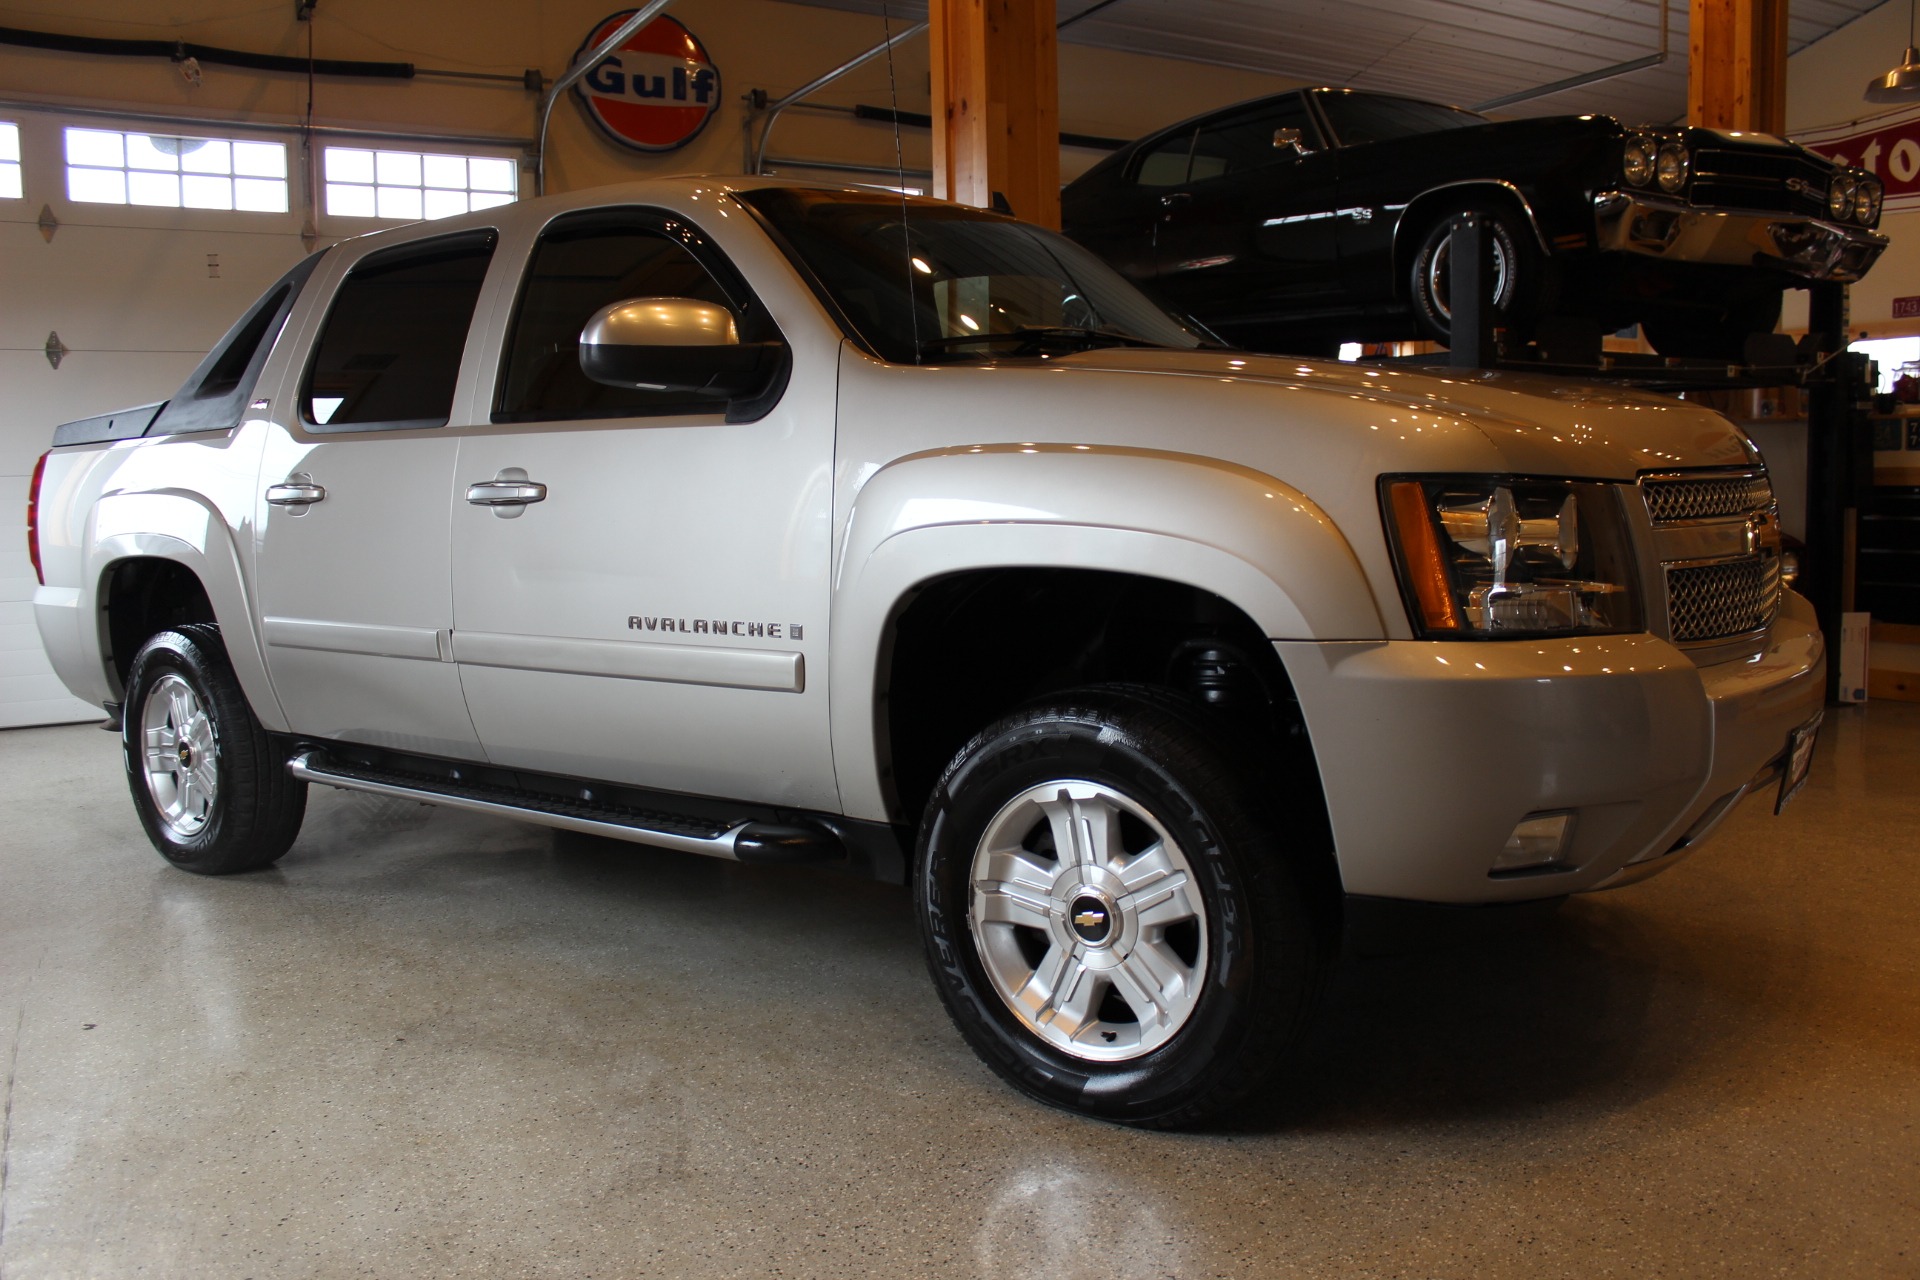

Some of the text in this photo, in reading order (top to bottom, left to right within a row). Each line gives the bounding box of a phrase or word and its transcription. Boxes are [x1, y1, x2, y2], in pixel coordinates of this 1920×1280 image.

[585, 55, 714, 104] Gulf
[1351, 206, 1373, 219] SS
[628, 615, 782, 639] AVALANCHE
